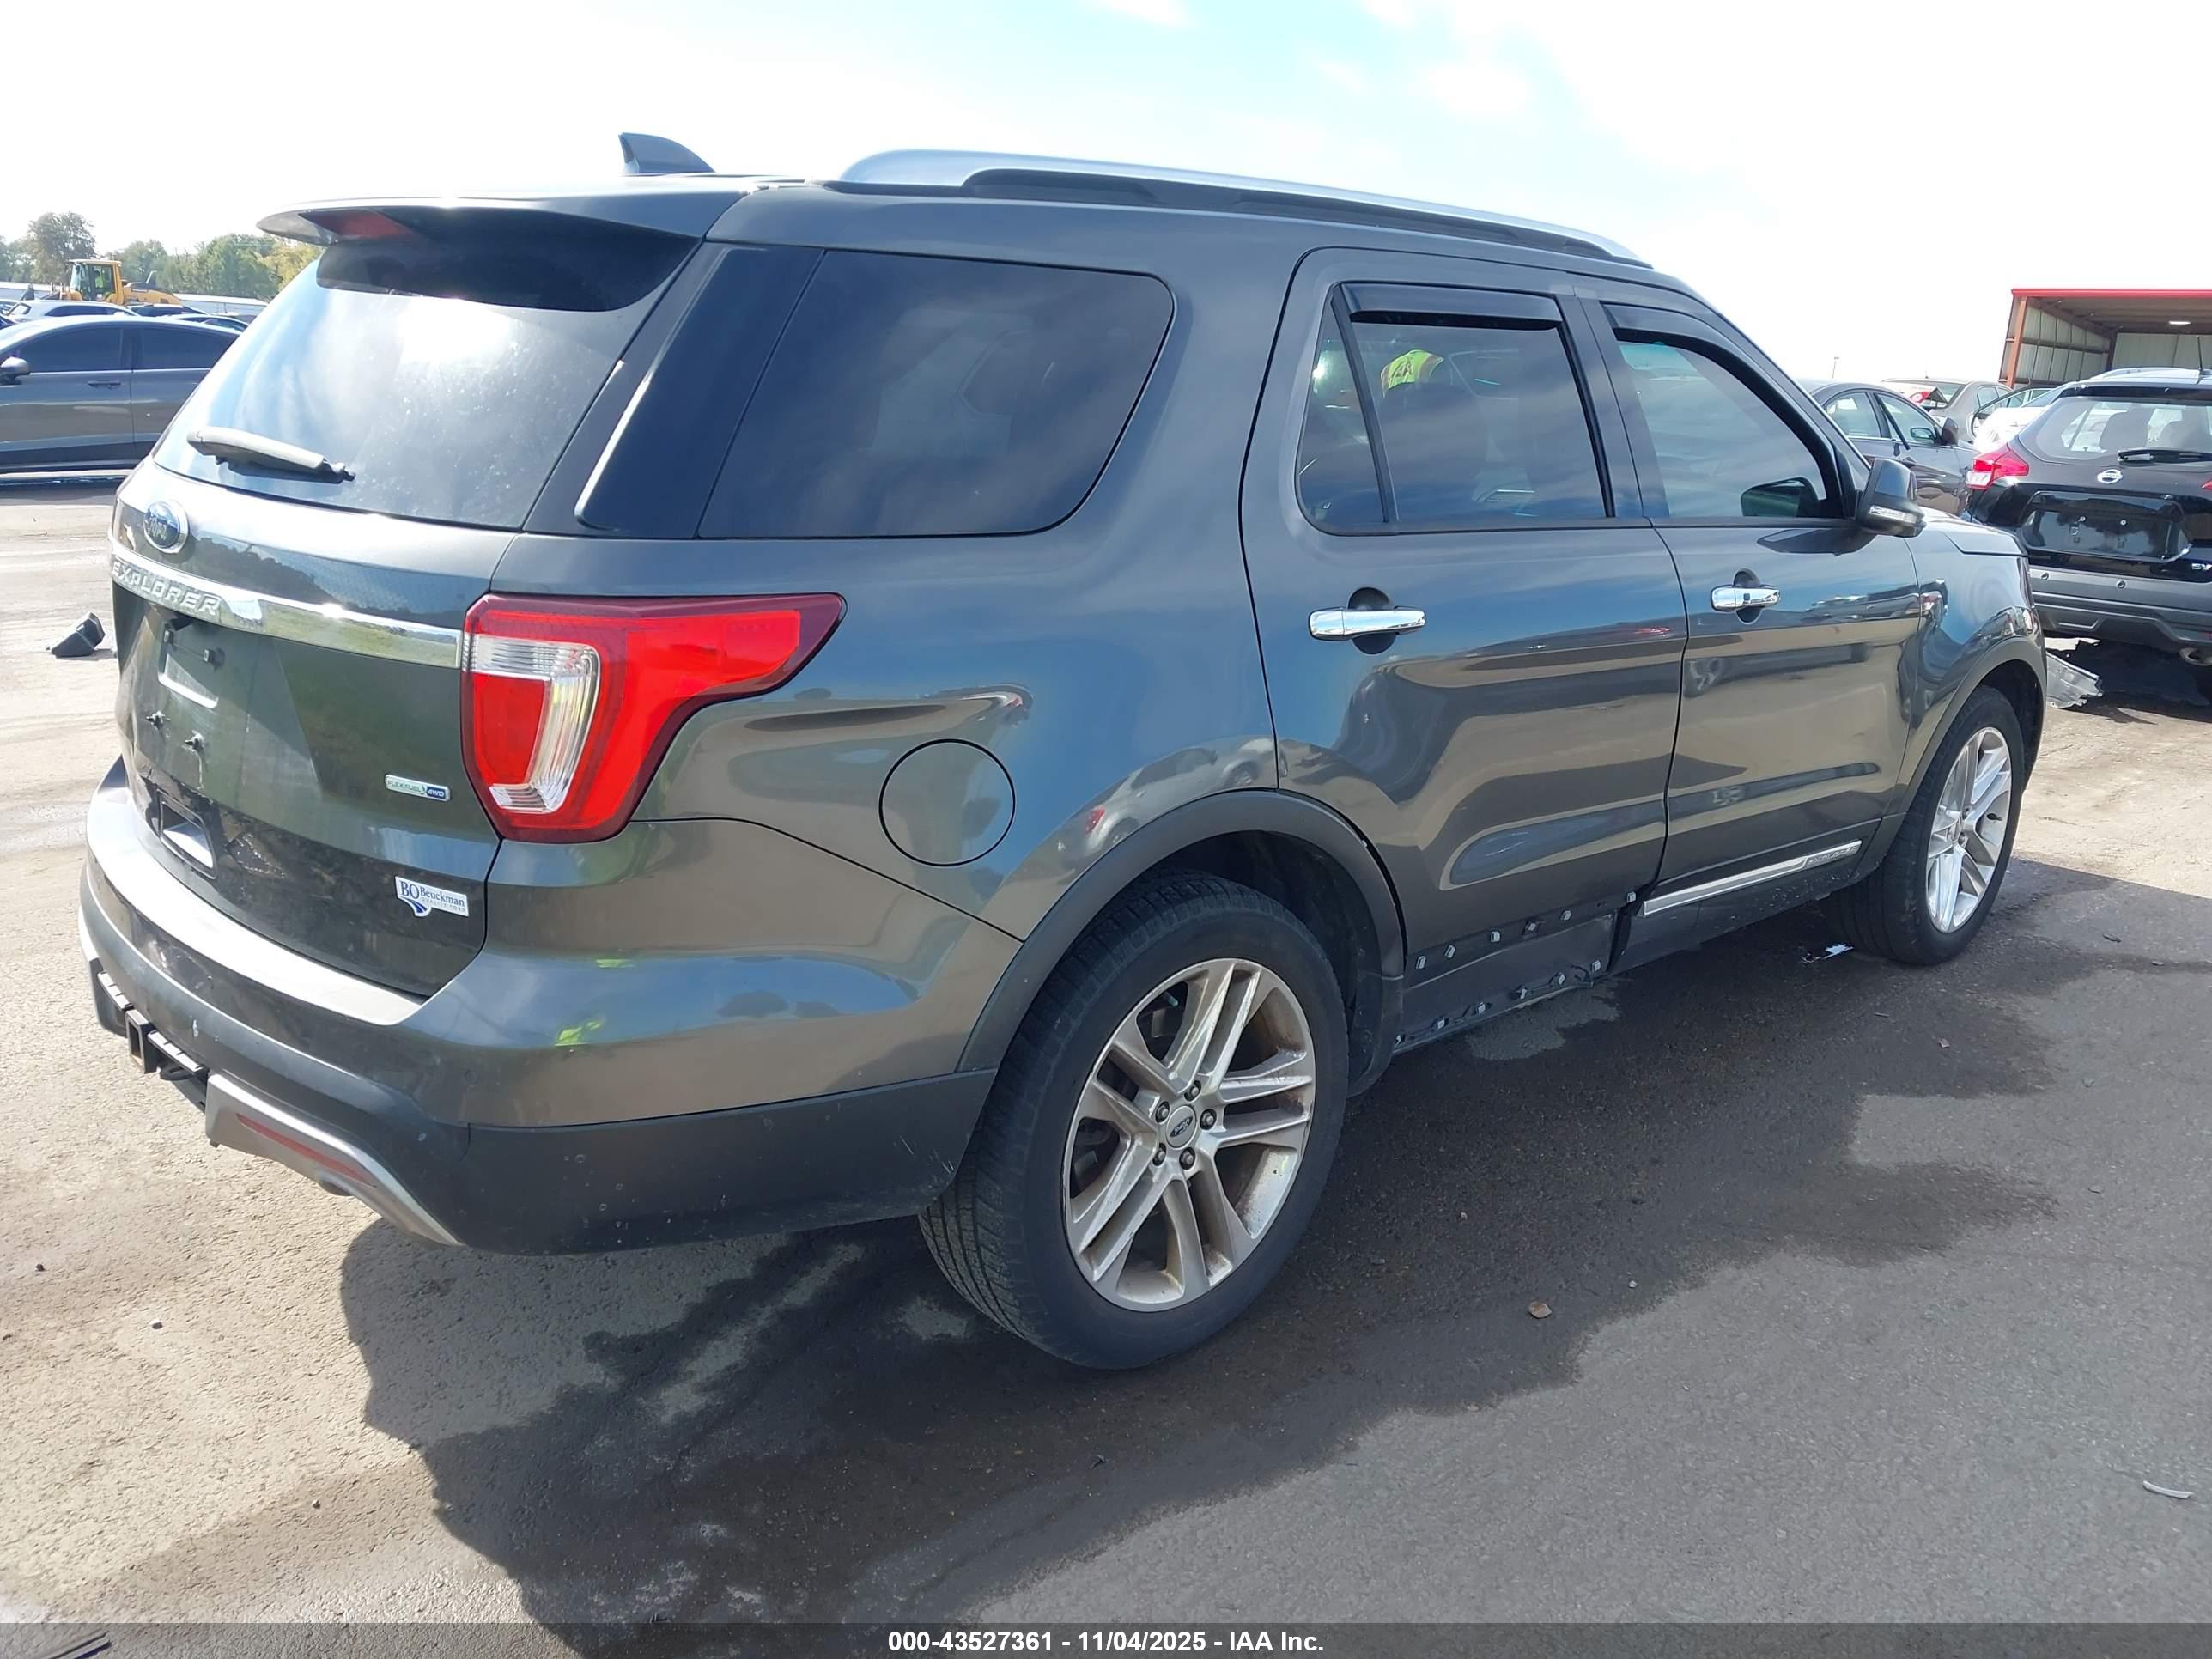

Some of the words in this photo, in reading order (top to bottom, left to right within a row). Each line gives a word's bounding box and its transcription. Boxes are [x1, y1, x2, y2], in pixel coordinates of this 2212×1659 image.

[112, 561, 221, 616] EXPLORER
[428, 788, 445, 798] 4WD
[420, 886, 465, 908] Beuckman
